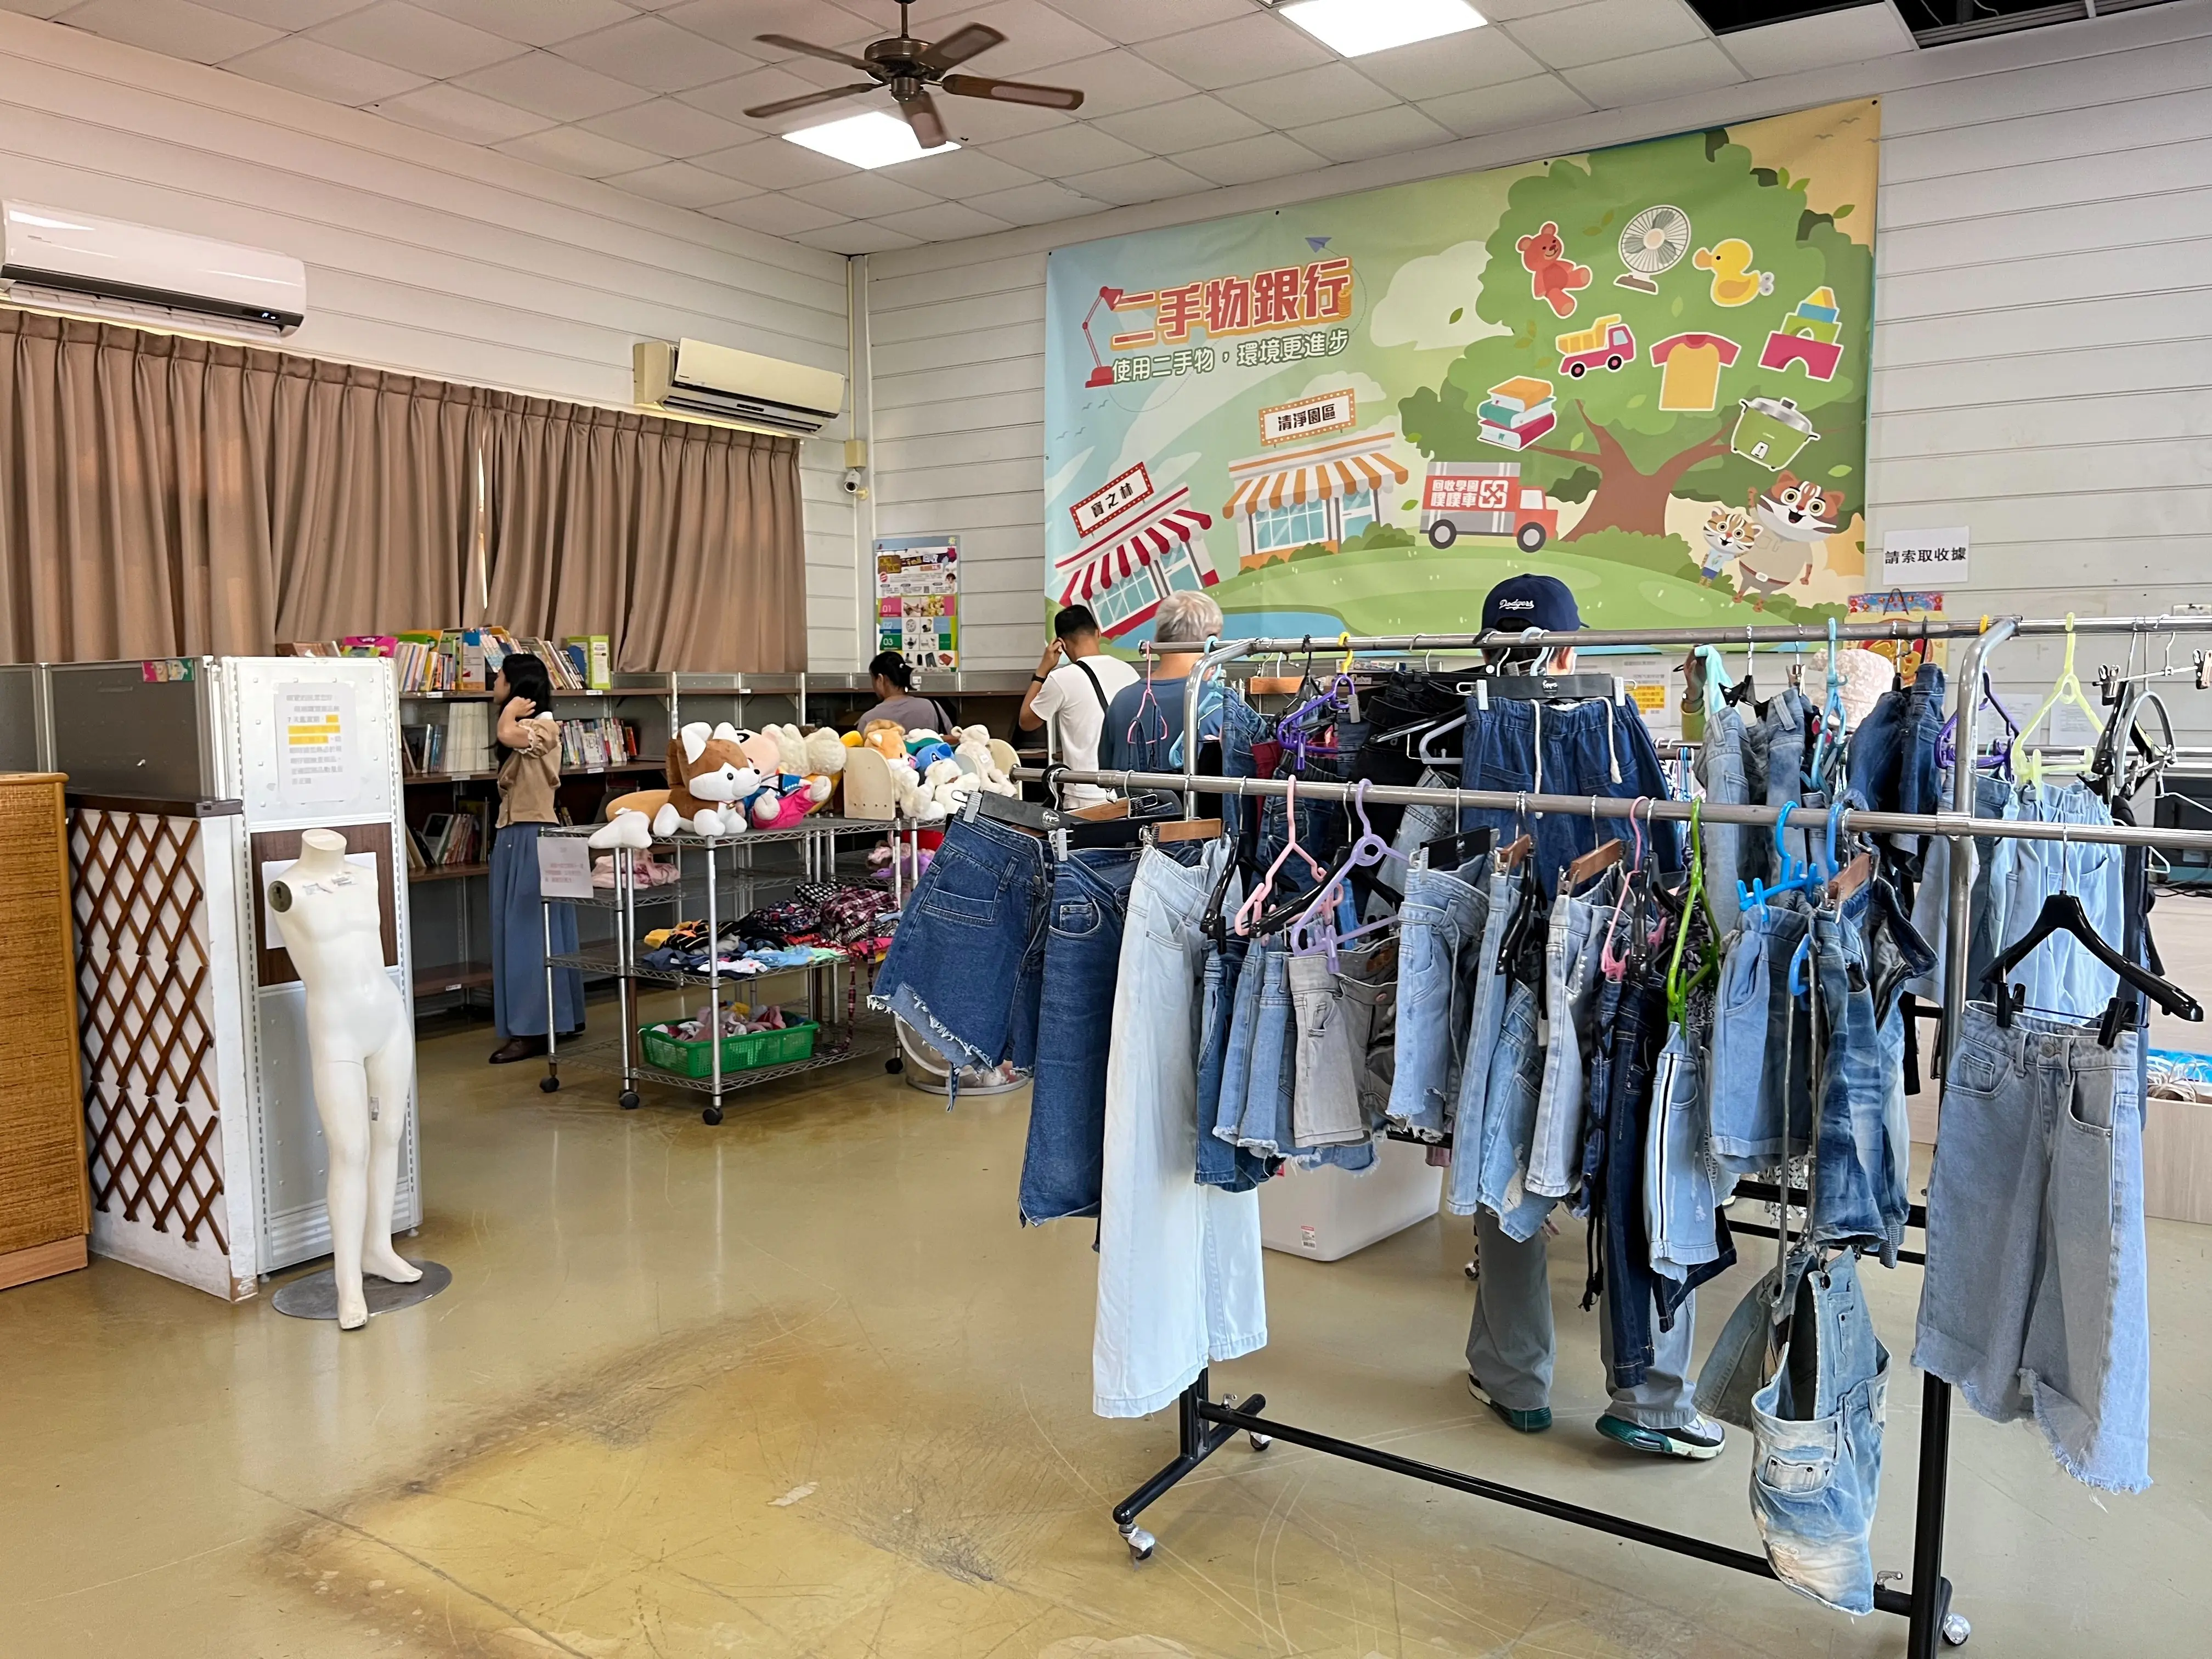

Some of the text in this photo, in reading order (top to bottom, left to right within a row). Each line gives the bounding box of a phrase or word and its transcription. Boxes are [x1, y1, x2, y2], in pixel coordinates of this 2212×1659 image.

[1112, 257, 1352, 347] 二手物銀行
[1112, 330, 1350, 383] 使用二手物，環境更進步
[1278, 403, 1336, 431] 清淨園區
[1884, 546, 1966, 565] 請索取收據
[883, 637, 893, 646] 03
